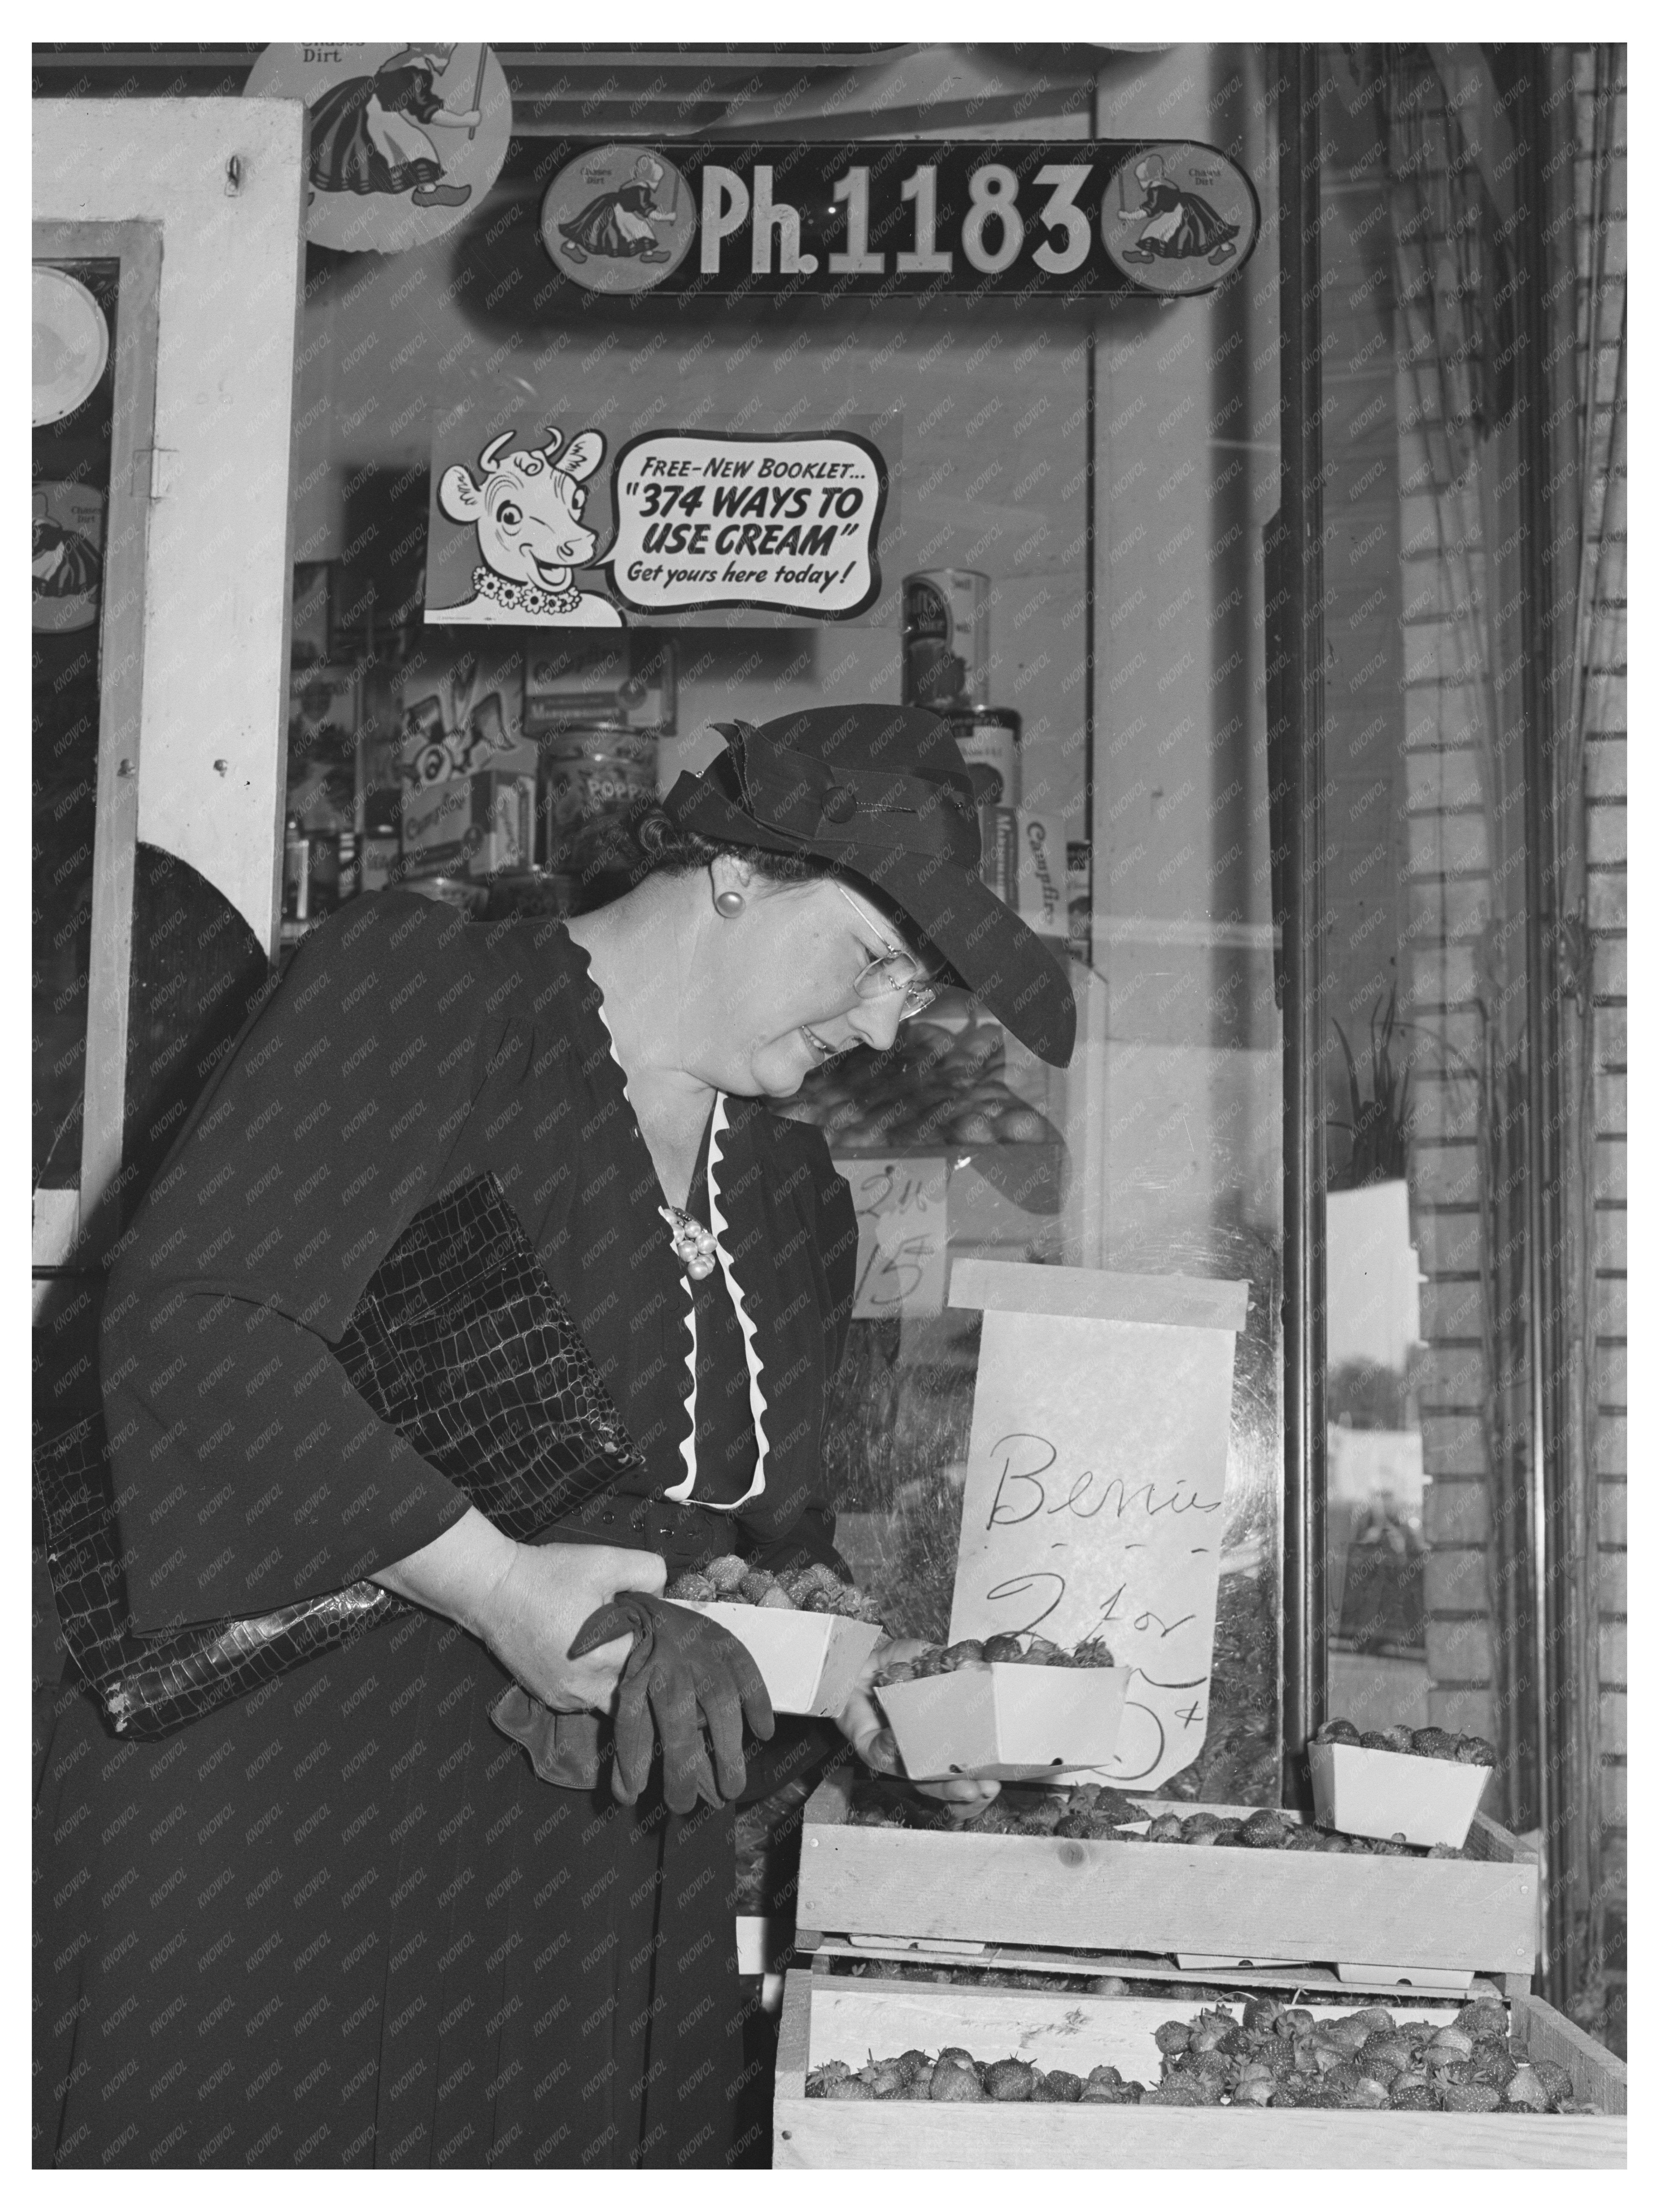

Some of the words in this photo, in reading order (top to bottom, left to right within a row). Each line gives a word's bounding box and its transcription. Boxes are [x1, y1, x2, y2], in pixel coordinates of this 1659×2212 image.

[303, 49, 342, 62] Dirt
[587, 176, 605, 184] Dirt
[1195, 177, 1213, 185] Dirt
[713, 486, 812, 519] WAYS
[818, 487, 864, 519] TO
[642, 523, 711, 554] USE
[627, 561, 664, 581] Get
[663, 568, 718, 589] yours
[722, 560, 768, 583] here
